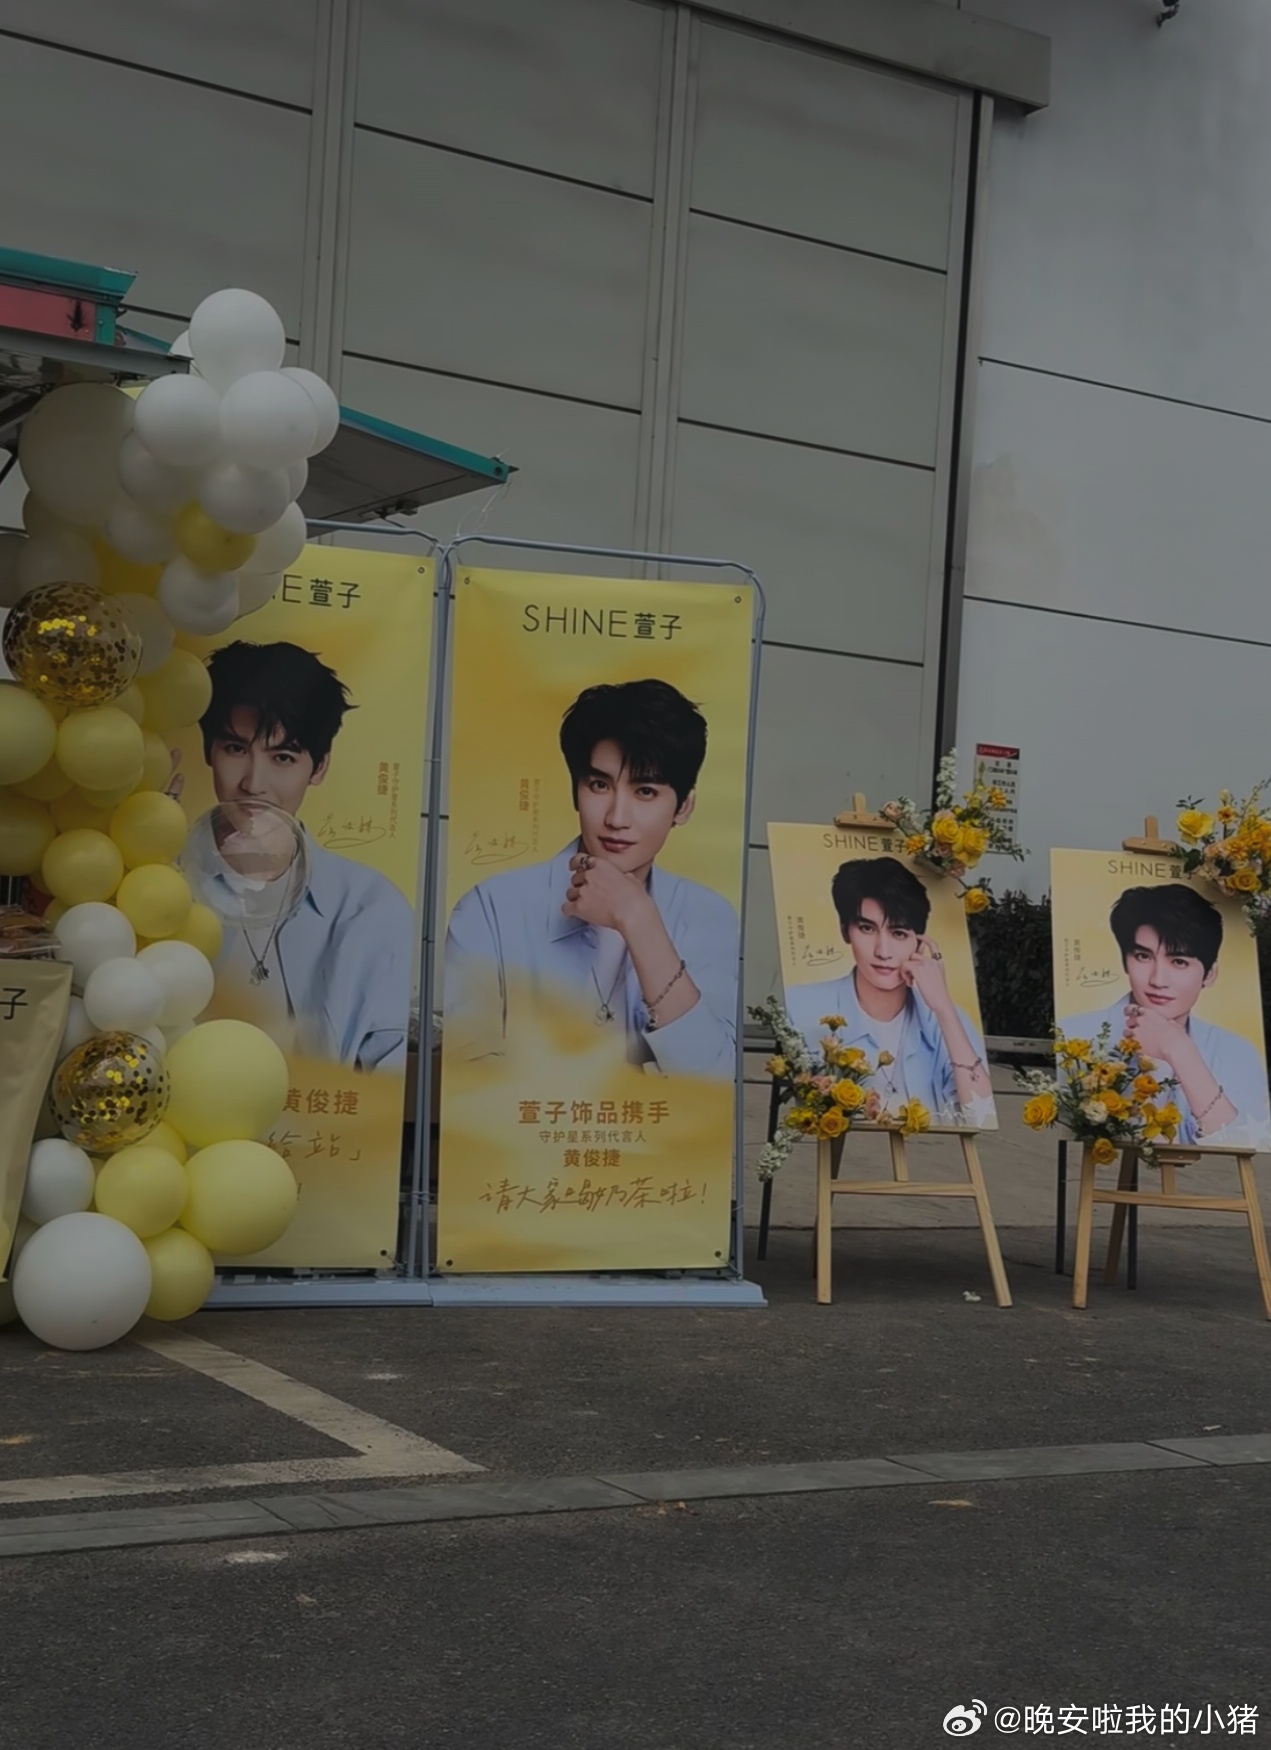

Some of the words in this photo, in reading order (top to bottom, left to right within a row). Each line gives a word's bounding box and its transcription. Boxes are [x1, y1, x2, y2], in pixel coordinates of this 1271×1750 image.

[273, 574, 361, 609] E萱子
[282, 1087, 359, 1116] 黄俊捷
[518, 1099, 670, 1125] 萱子饰品携手
[538, 1130, 647, 1144] 守护星系列代言人
[562, 1148, 622, 1168] 黄俊捷
